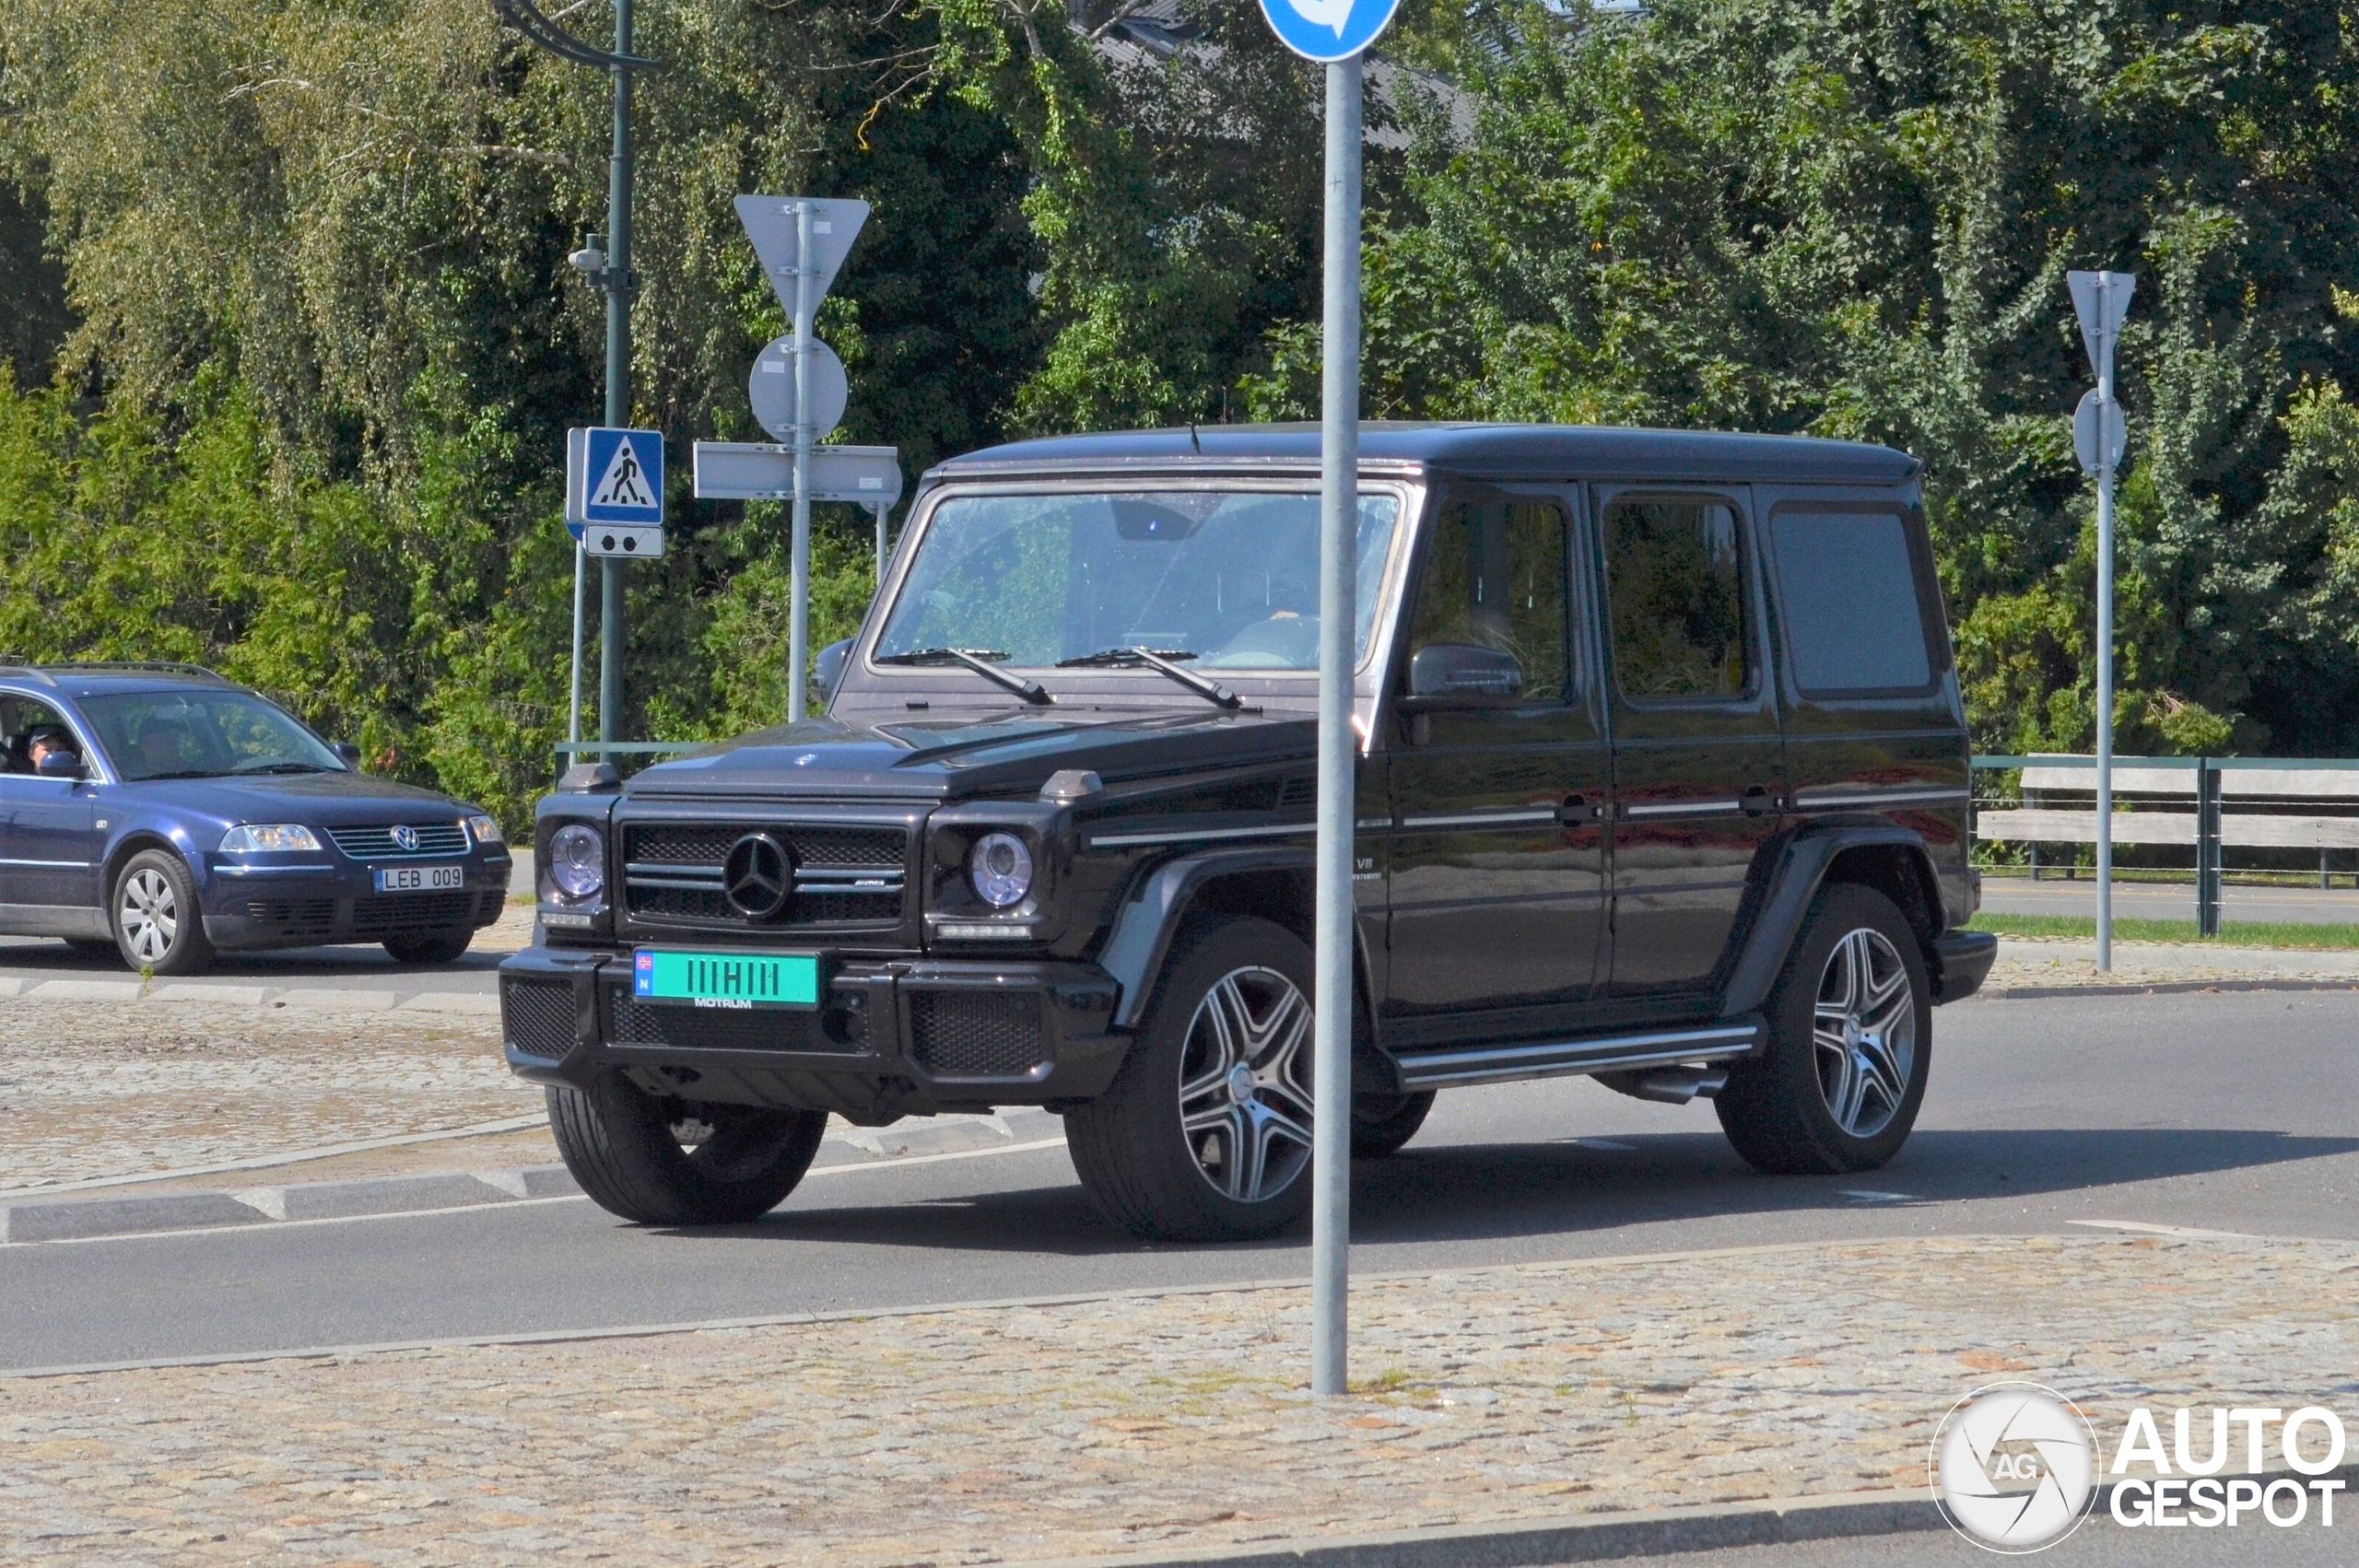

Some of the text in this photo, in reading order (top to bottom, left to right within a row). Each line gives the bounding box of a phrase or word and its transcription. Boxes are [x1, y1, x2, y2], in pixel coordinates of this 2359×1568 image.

[1356, 858, 1373, 870] V8
[385, 870, 421, 889] LEB
[432, 868, 461, 886] 009
[640, 978, 648, 989] N
[694, 997, 752, 1010] MOTRUM
